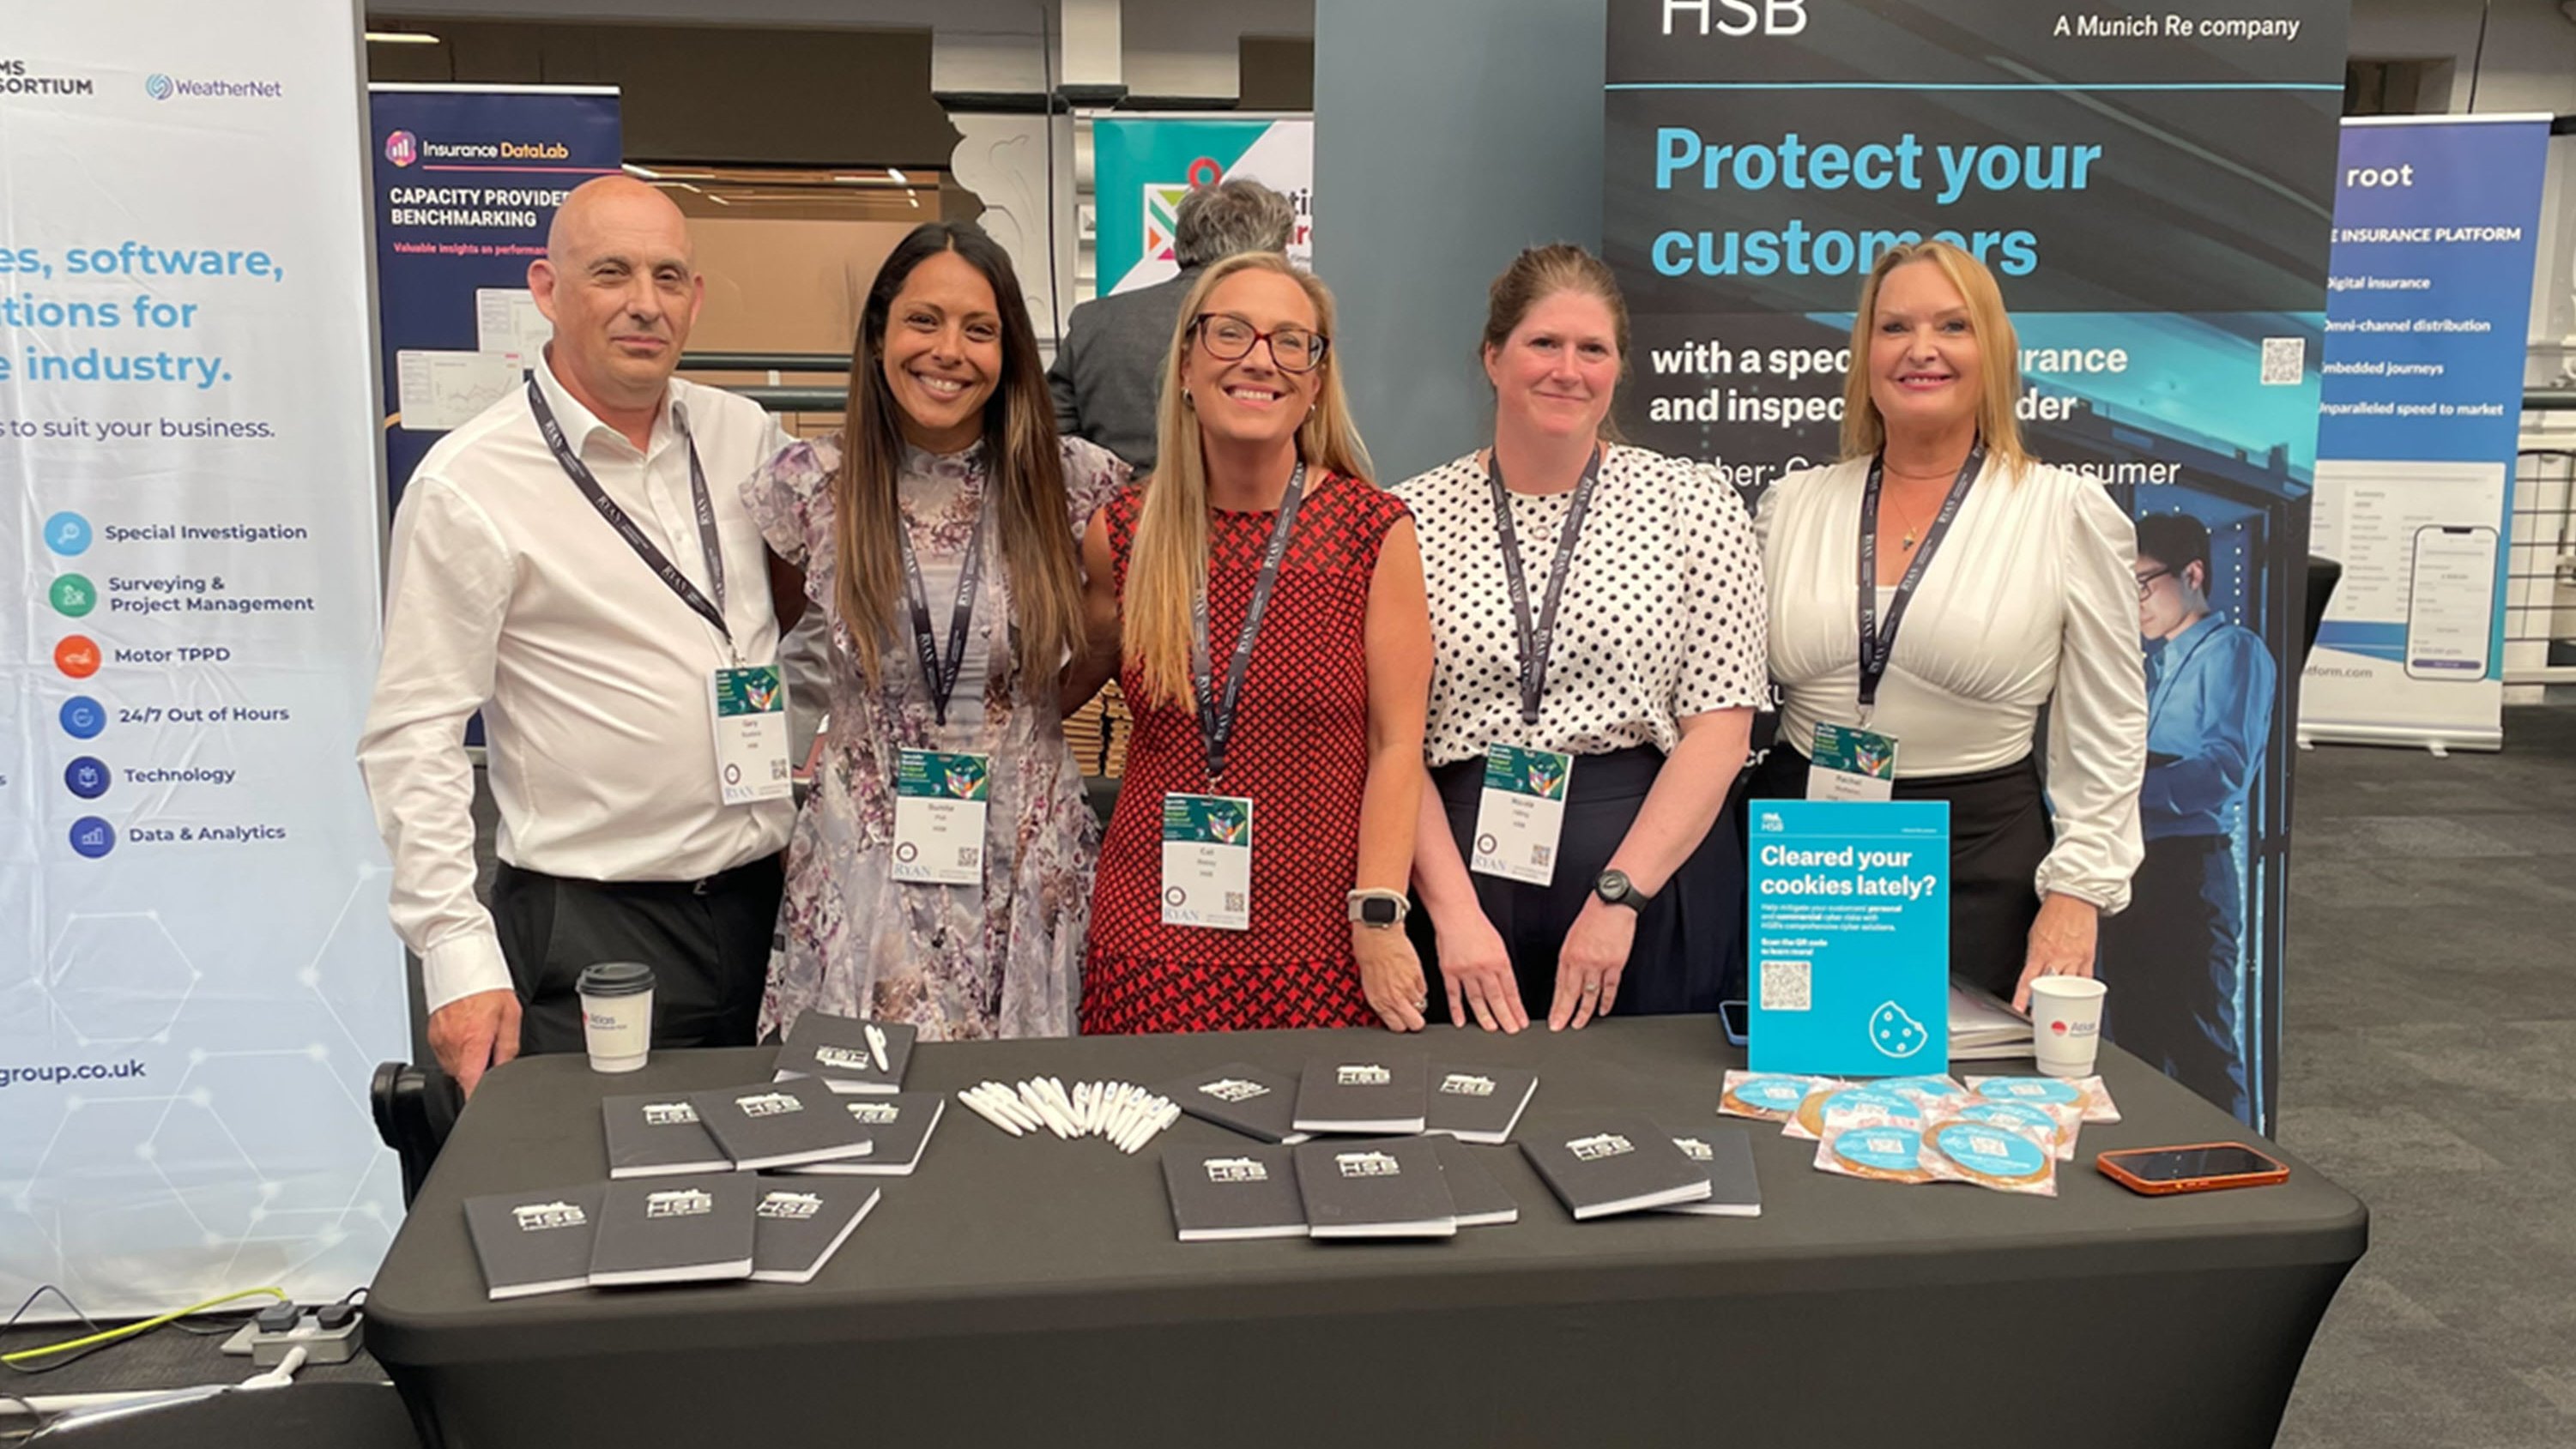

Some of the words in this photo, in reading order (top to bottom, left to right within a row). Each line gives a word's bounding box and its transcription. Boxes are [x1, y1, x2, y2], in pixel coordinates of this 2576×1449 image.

[2054, 16, 2071, 37] A
[2077, 15, 2158, 38] Munich
[2165, 16, 2194, 38] Re
[2199, 17, 2301, 41] company
[175, 79, 282, 98] WeatherNet
[423, 141, 499, 158] Insurance
[501, 142, 569, 160] DataLab
[1655, 127, 1923, 190] Protect
[1937, 146, 2101, 204] your
[2347, 164, 2414, 187] root
[390, 188, 481, 205] CAPACITY
[391, 208, 536, 227] BENCHMARKING
[2341, 228, 2431, 243] INSURANCE
[2435, 227, 2522, 242] PLATFORM
[393, 243, 437, 254] Valuable
[439, 244, 479, 256] insights
[481, 245, 493, 254] on
[66, 241, 284, 281] software,
[2367, 276, 2431, 290] insurance
[133, 294, 198, 328] for
[2413, 319, 2491, 333] distribution
[1652, 341, 1732, 373] with
[1739, 349, 1762, 373] a
[2018, 348, 2128, 373] rance
[27, 347, 232, 389] industry.
[2322, 362, 2385, 375] mbedded
[2386, 362, 2444, 377] journeys
[1649, 389, 1720, 421] and
[2397, 403, 2436, 417] speed
[2440, 403, 2453, 415] to
[2457, 403, 2504, 416] market
[11, 420, 36, 437] to
[44, 418, 90, 438] suit
[96, 421, 153, 441] your
[160, 417, 275, 438] business.
[106, 524, 175, 543] Special
[181, 524, 308, 542] Investigation
[109, 577, 207, 595] Surveying
[211, 578, 225, 592] &
[111, 597, 181, 615] Project
[187, 596, 315, 615] Management
[115, 649, 172, 663] Motor
[177, 647, 231, 662] TPPD
[119, 708, 161, 724] 24/7
[167, 708, 203, 723] Out
[208, 707, 228, 722] of
[233, 707, 290, 722] Hours
[124, 768, 236, 784] Technology
[130, 828, 174, 842] Data
[180, 827, 193, 842] &
[198, 824, 287, 842] Analytics
[1761, 844, 1853, 866] Cleared
[1857, 851, 1913, 872] your
[1761, 873, 1853, 895] cookies
[1857, 874, 1937, 901] lately?
[1867, 904, 1902, 913] personal
[1208, 1165, 1267, 1179] HSB
[1339, 1158, 1400, 1174] HSB
[648, 1198, 712, 1215] HSB
[756, 1200, 819, 1214] HSB
[518, 1210, 584, 1226] HSB
